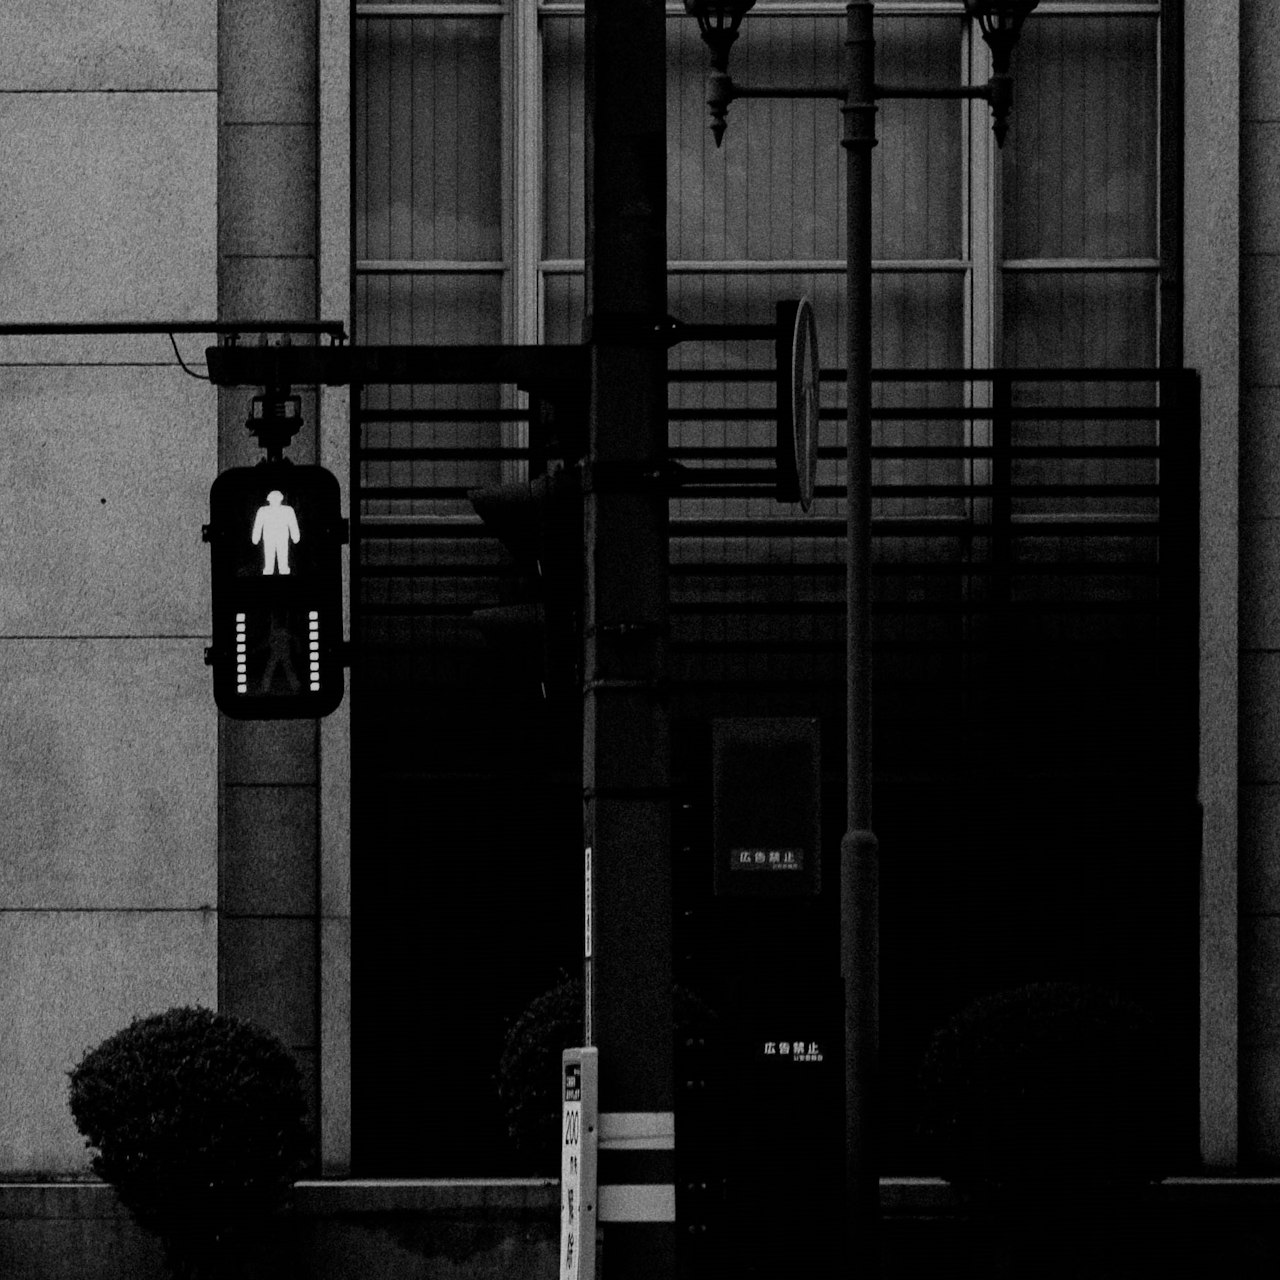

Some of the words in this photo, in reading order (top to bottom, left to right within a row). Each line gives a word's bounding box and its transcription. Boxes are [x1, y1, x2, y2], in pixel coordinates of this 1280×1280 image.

[740, 851, 795, 864] 広告禁止
[764, 1042, 819, 1054] 広告禁止
